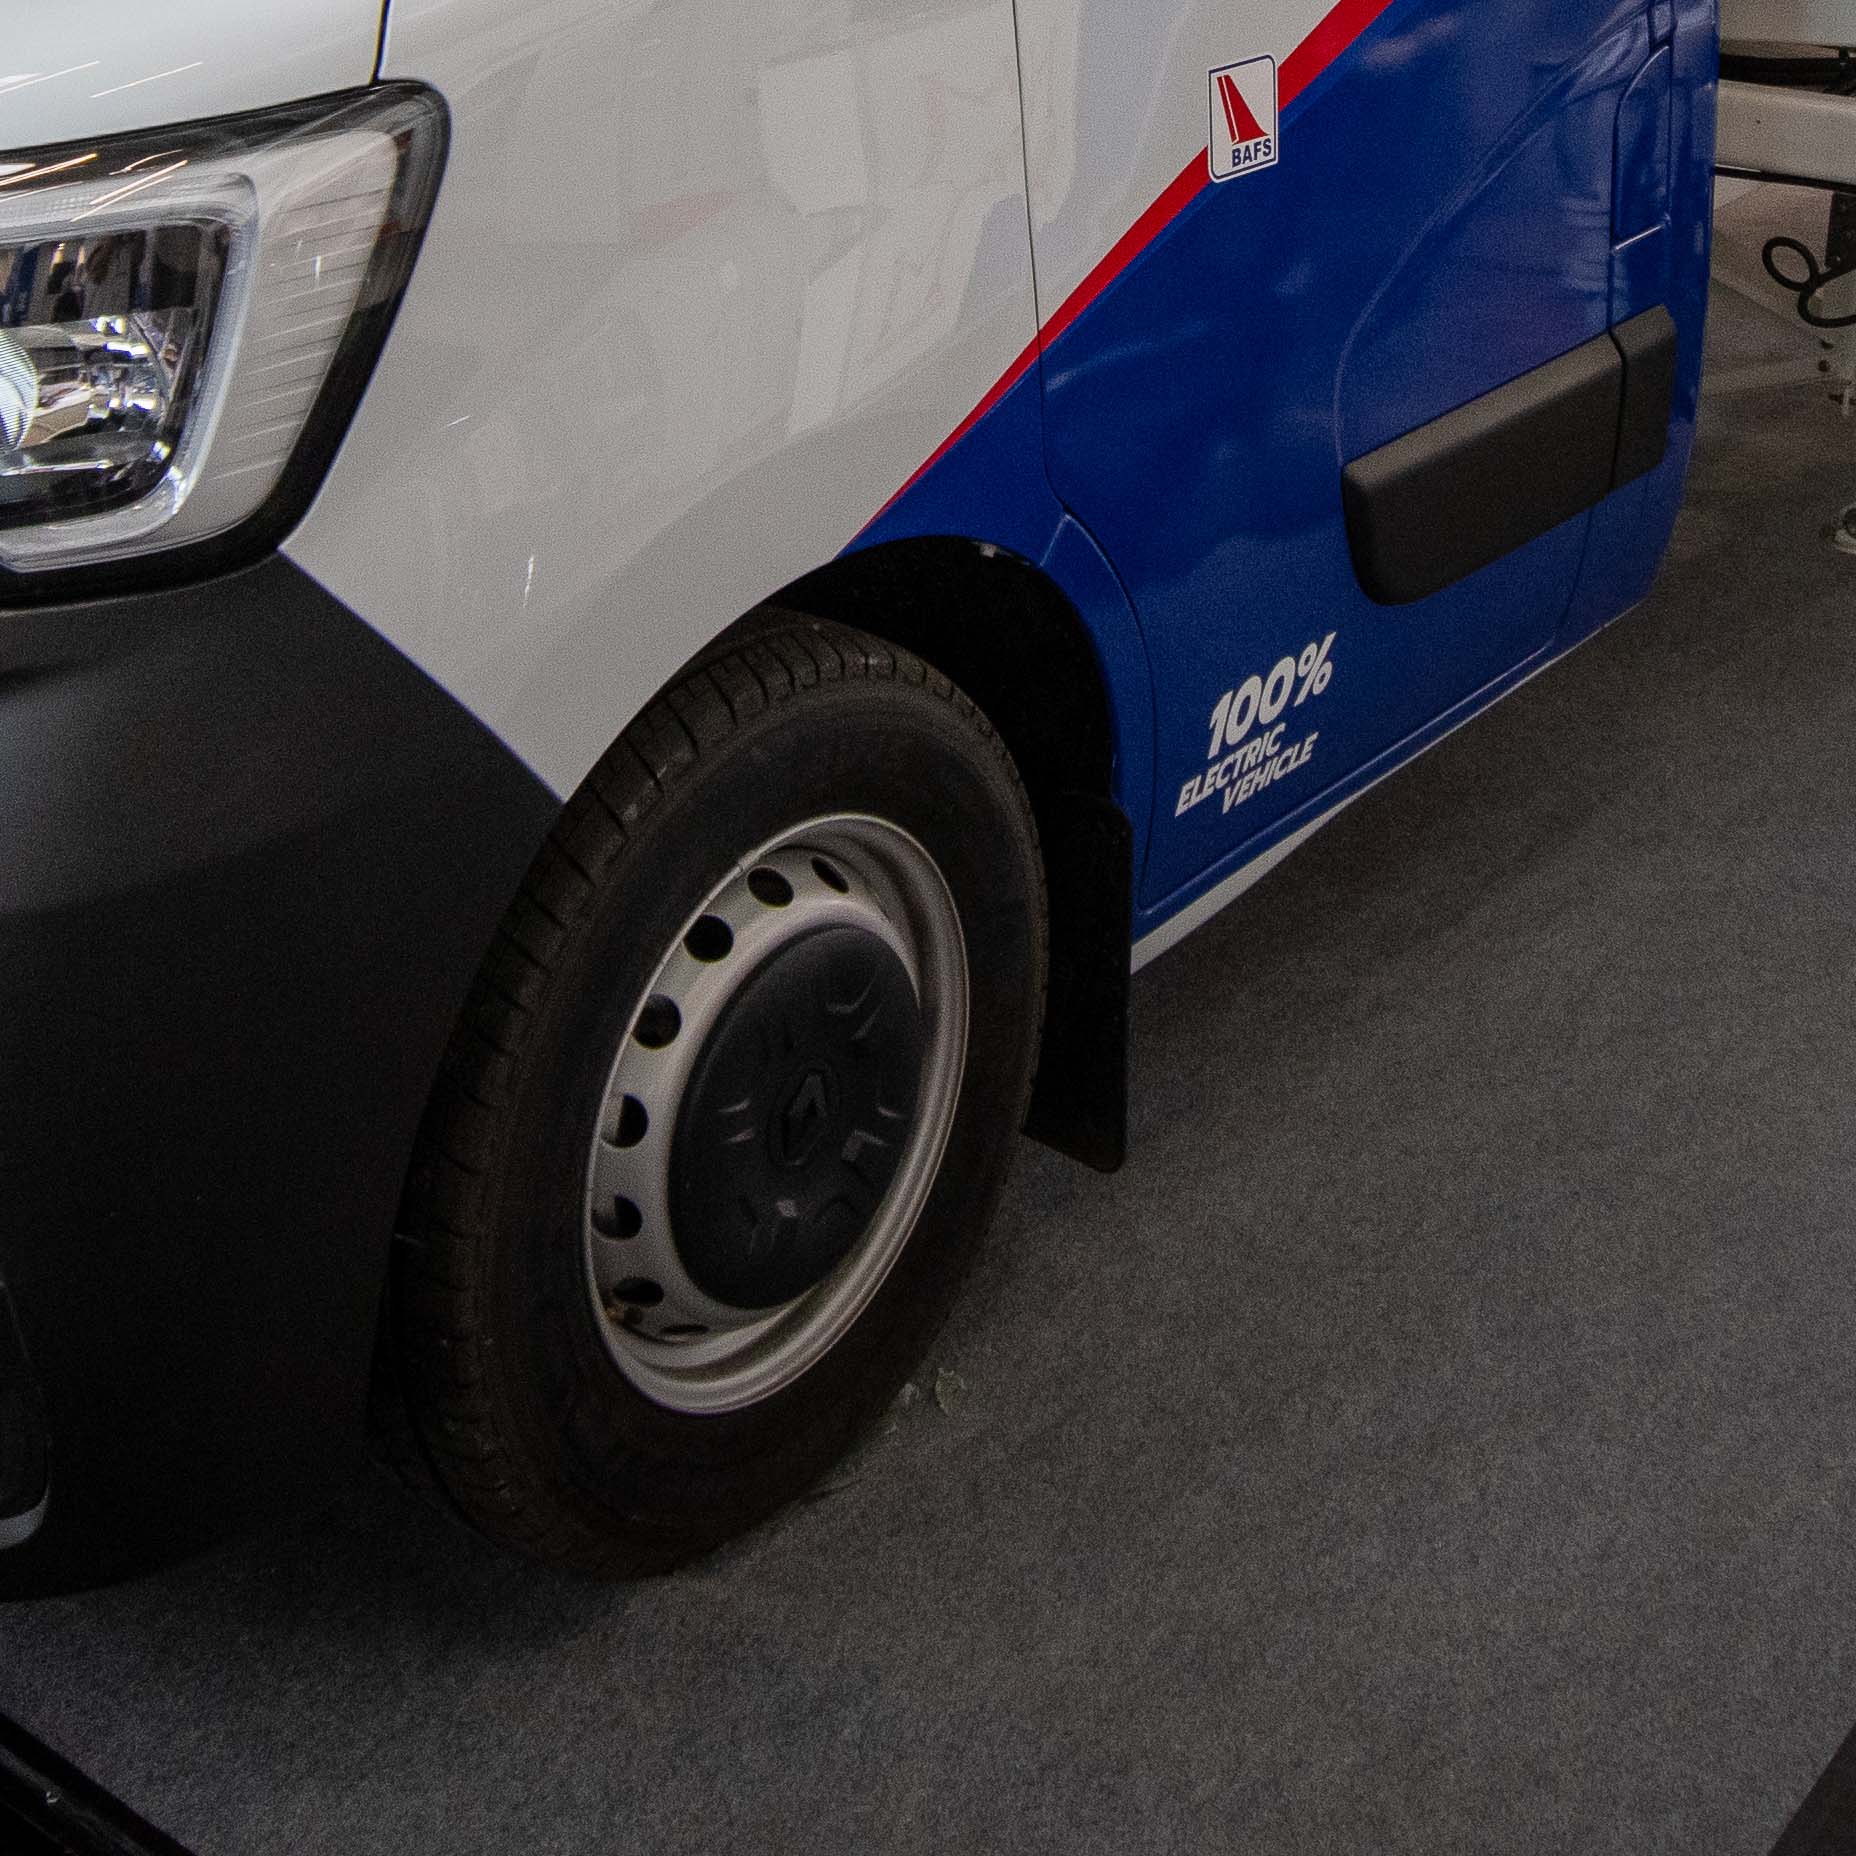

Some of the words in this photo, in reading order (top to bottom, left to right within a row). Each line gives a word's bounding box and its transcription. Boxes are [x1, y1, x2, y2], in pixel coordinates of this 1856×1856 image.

[1231, 138, 1272, 168] BAFS
[1208, 631, 1337, 760] 100%
[1175, 722, 1286, 818] ELECTRIC
[1222, 731, 1320, 815] VEHICLE
